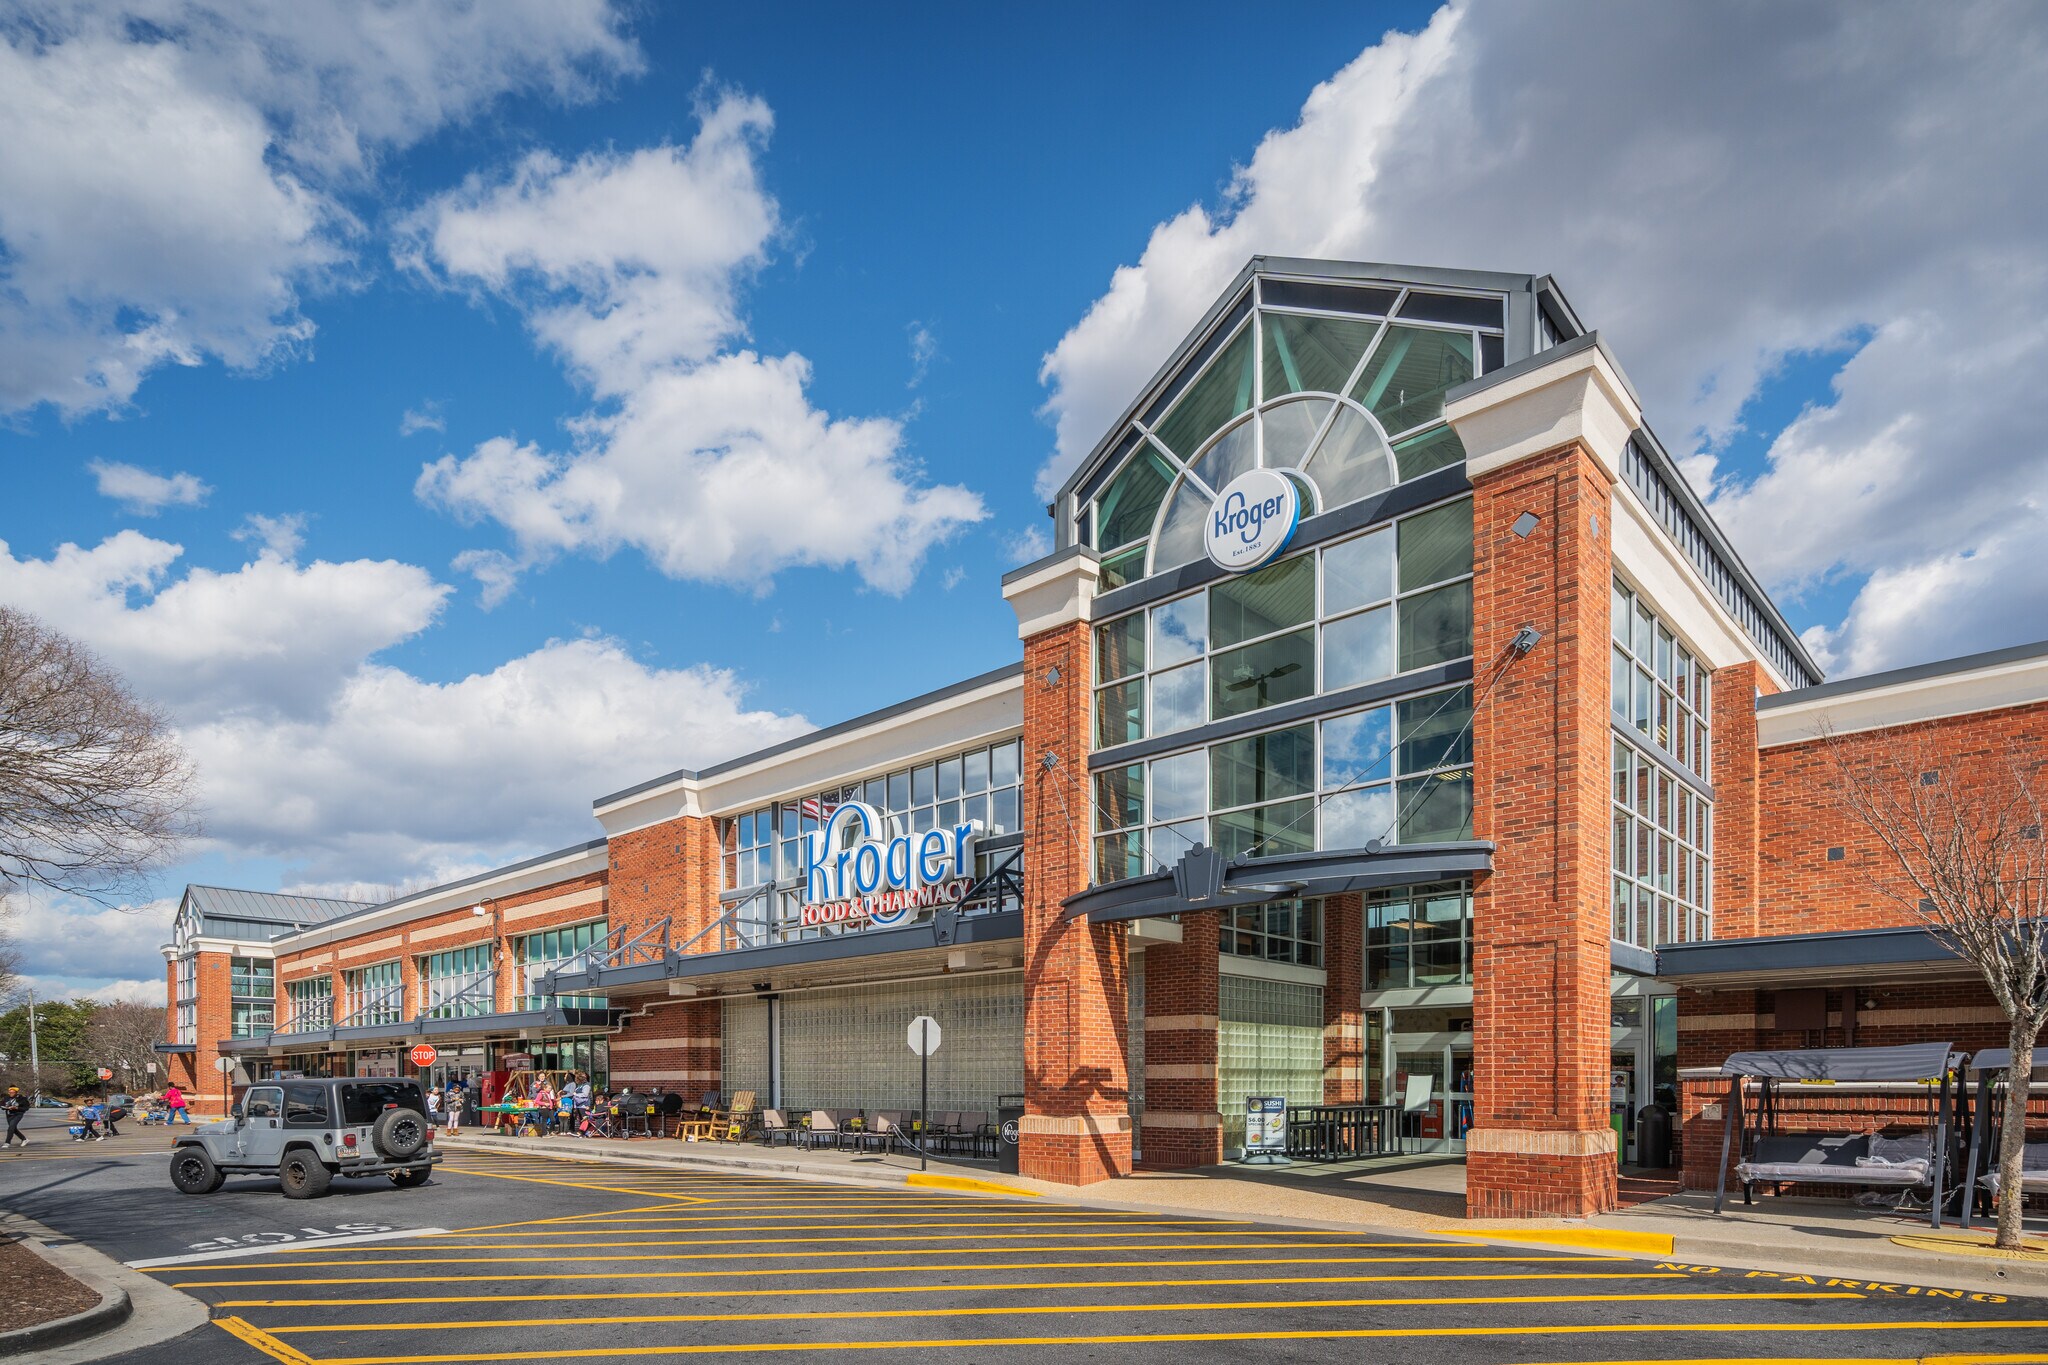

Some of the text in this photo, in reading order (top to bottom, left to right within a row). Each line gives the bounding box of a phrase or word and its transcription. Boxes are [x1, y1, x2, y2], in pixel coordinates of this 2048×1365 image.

[1214, 491, 1284, 543] Kroger
[806, 801, 984, 927] Kroger
[800, 879, 974, 926] FOOD & PHARMACY
[413, 1051, 435, 1060] STOP
[1653, 1262, 2008, 1304] NO PARKING
